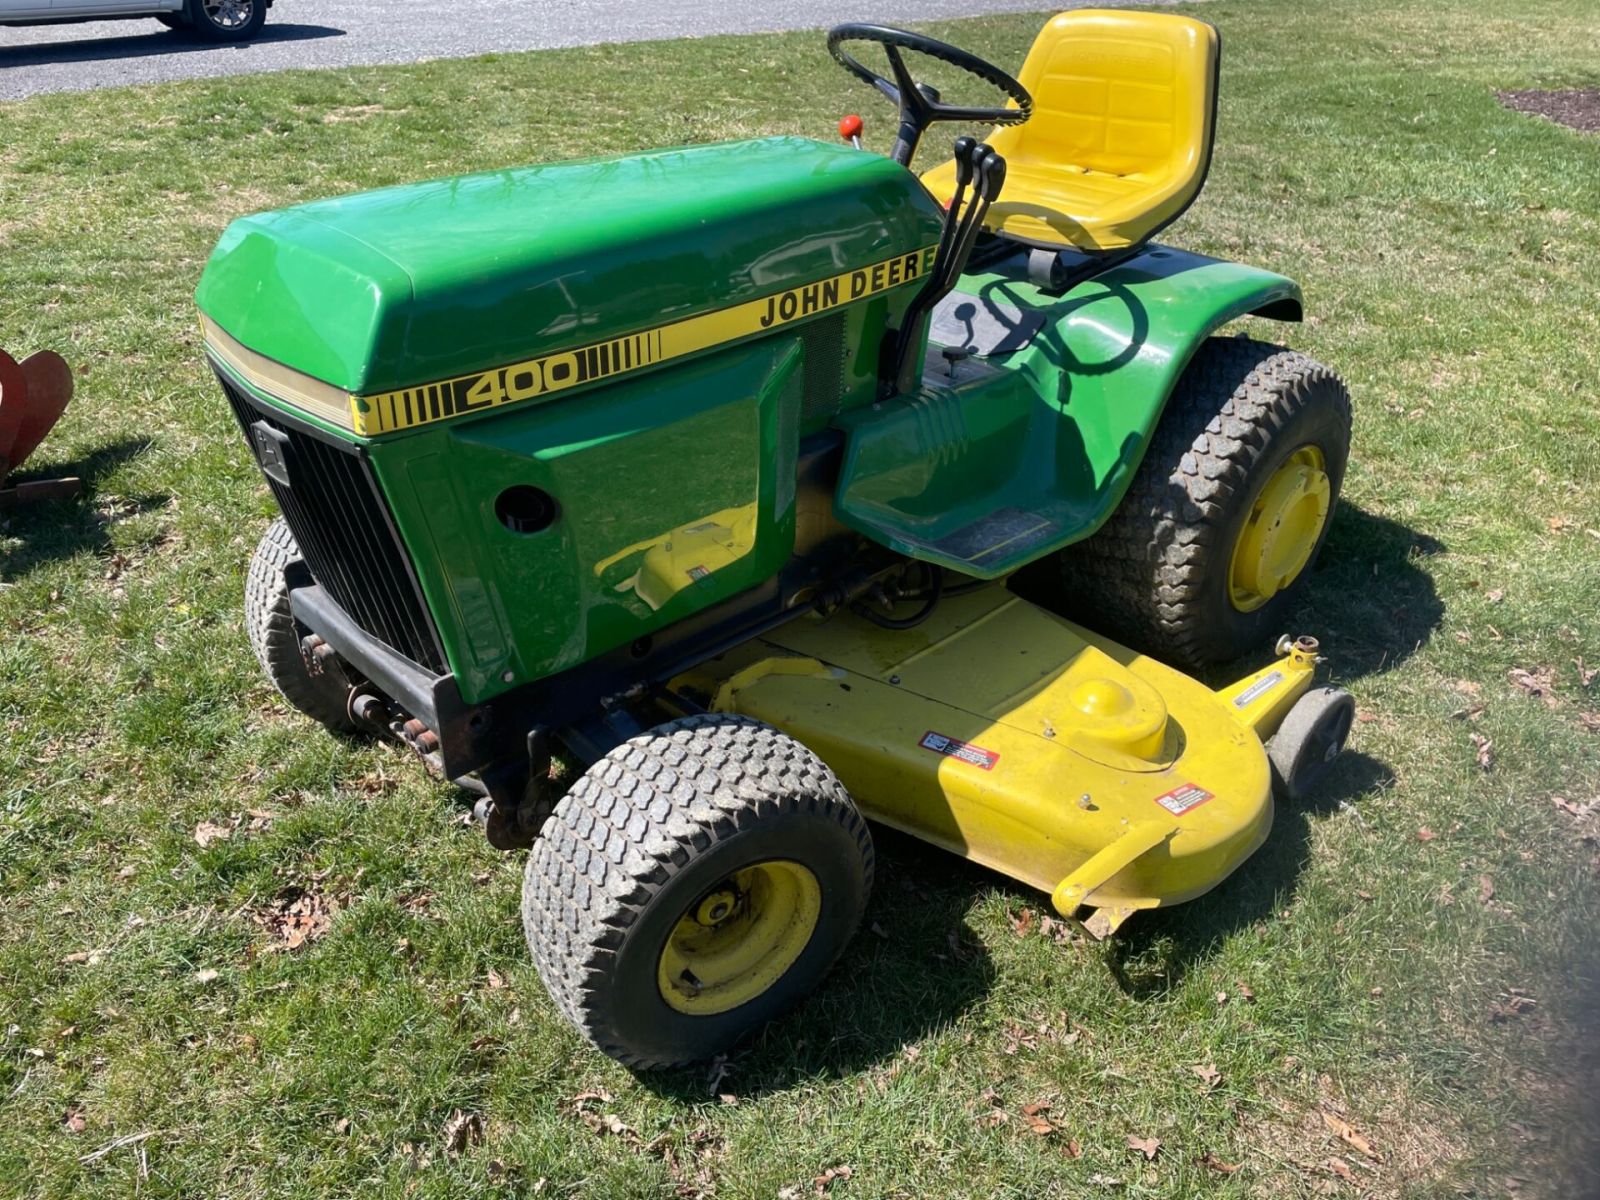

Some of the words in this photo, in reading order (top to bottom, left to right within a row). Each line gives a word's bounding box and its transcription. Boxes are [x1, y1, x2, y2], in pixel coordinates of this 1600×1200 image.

[760, 278, 839, 328] JOHN
[850, 247, 936, 299] DEERE
[466, 351, 579, 406] 400
